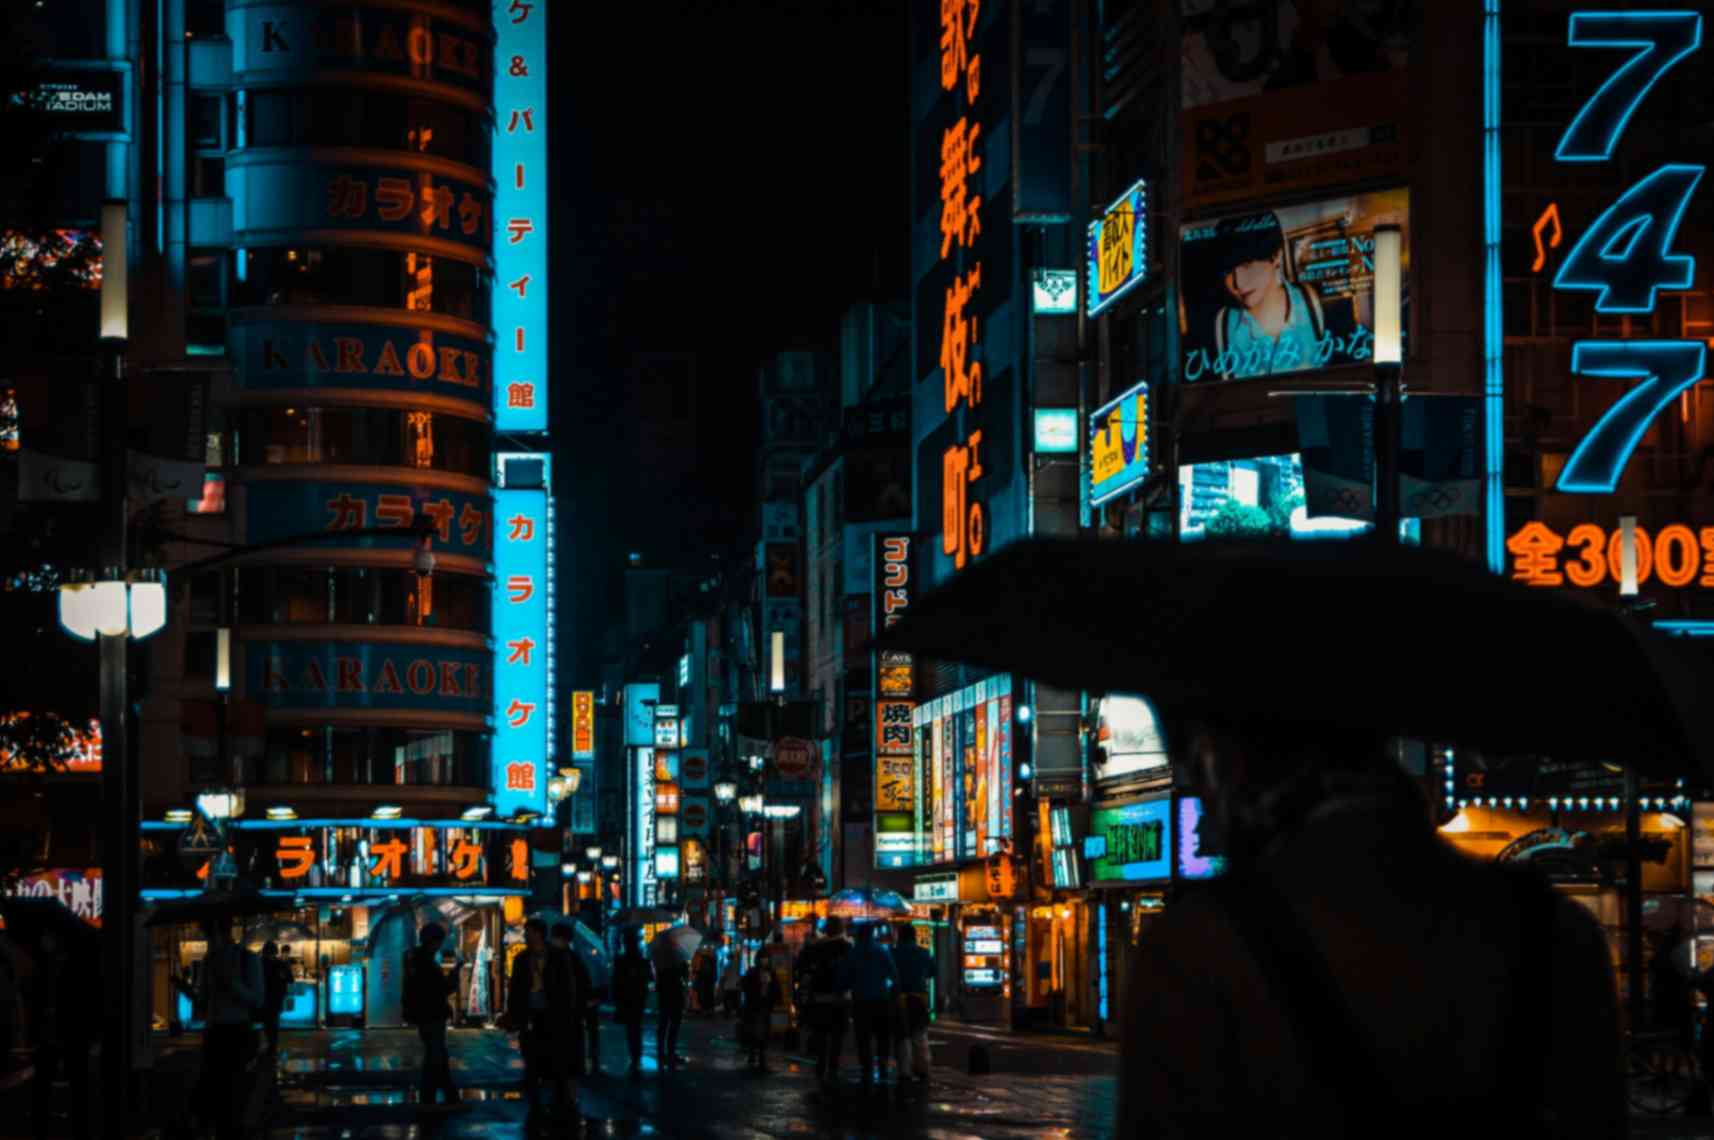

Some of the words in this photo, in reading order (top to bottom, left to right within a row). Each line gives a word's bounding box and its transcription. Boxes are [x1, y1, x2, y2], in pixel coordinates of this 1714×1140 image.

[327, 173, 482, 236] カラオケ
[1552, 10, 1707, 495] 747
[262, 335, 481, 388] KARAOKE
[324, 495, 484, 544] カラオケ
[1506, 521, 1714, 588] 全300
[260, 655, 481, 699] KARAOKE
[507, 515, 534, 792] カラオケ館
[882, 703, 911, 744] 焼肉
